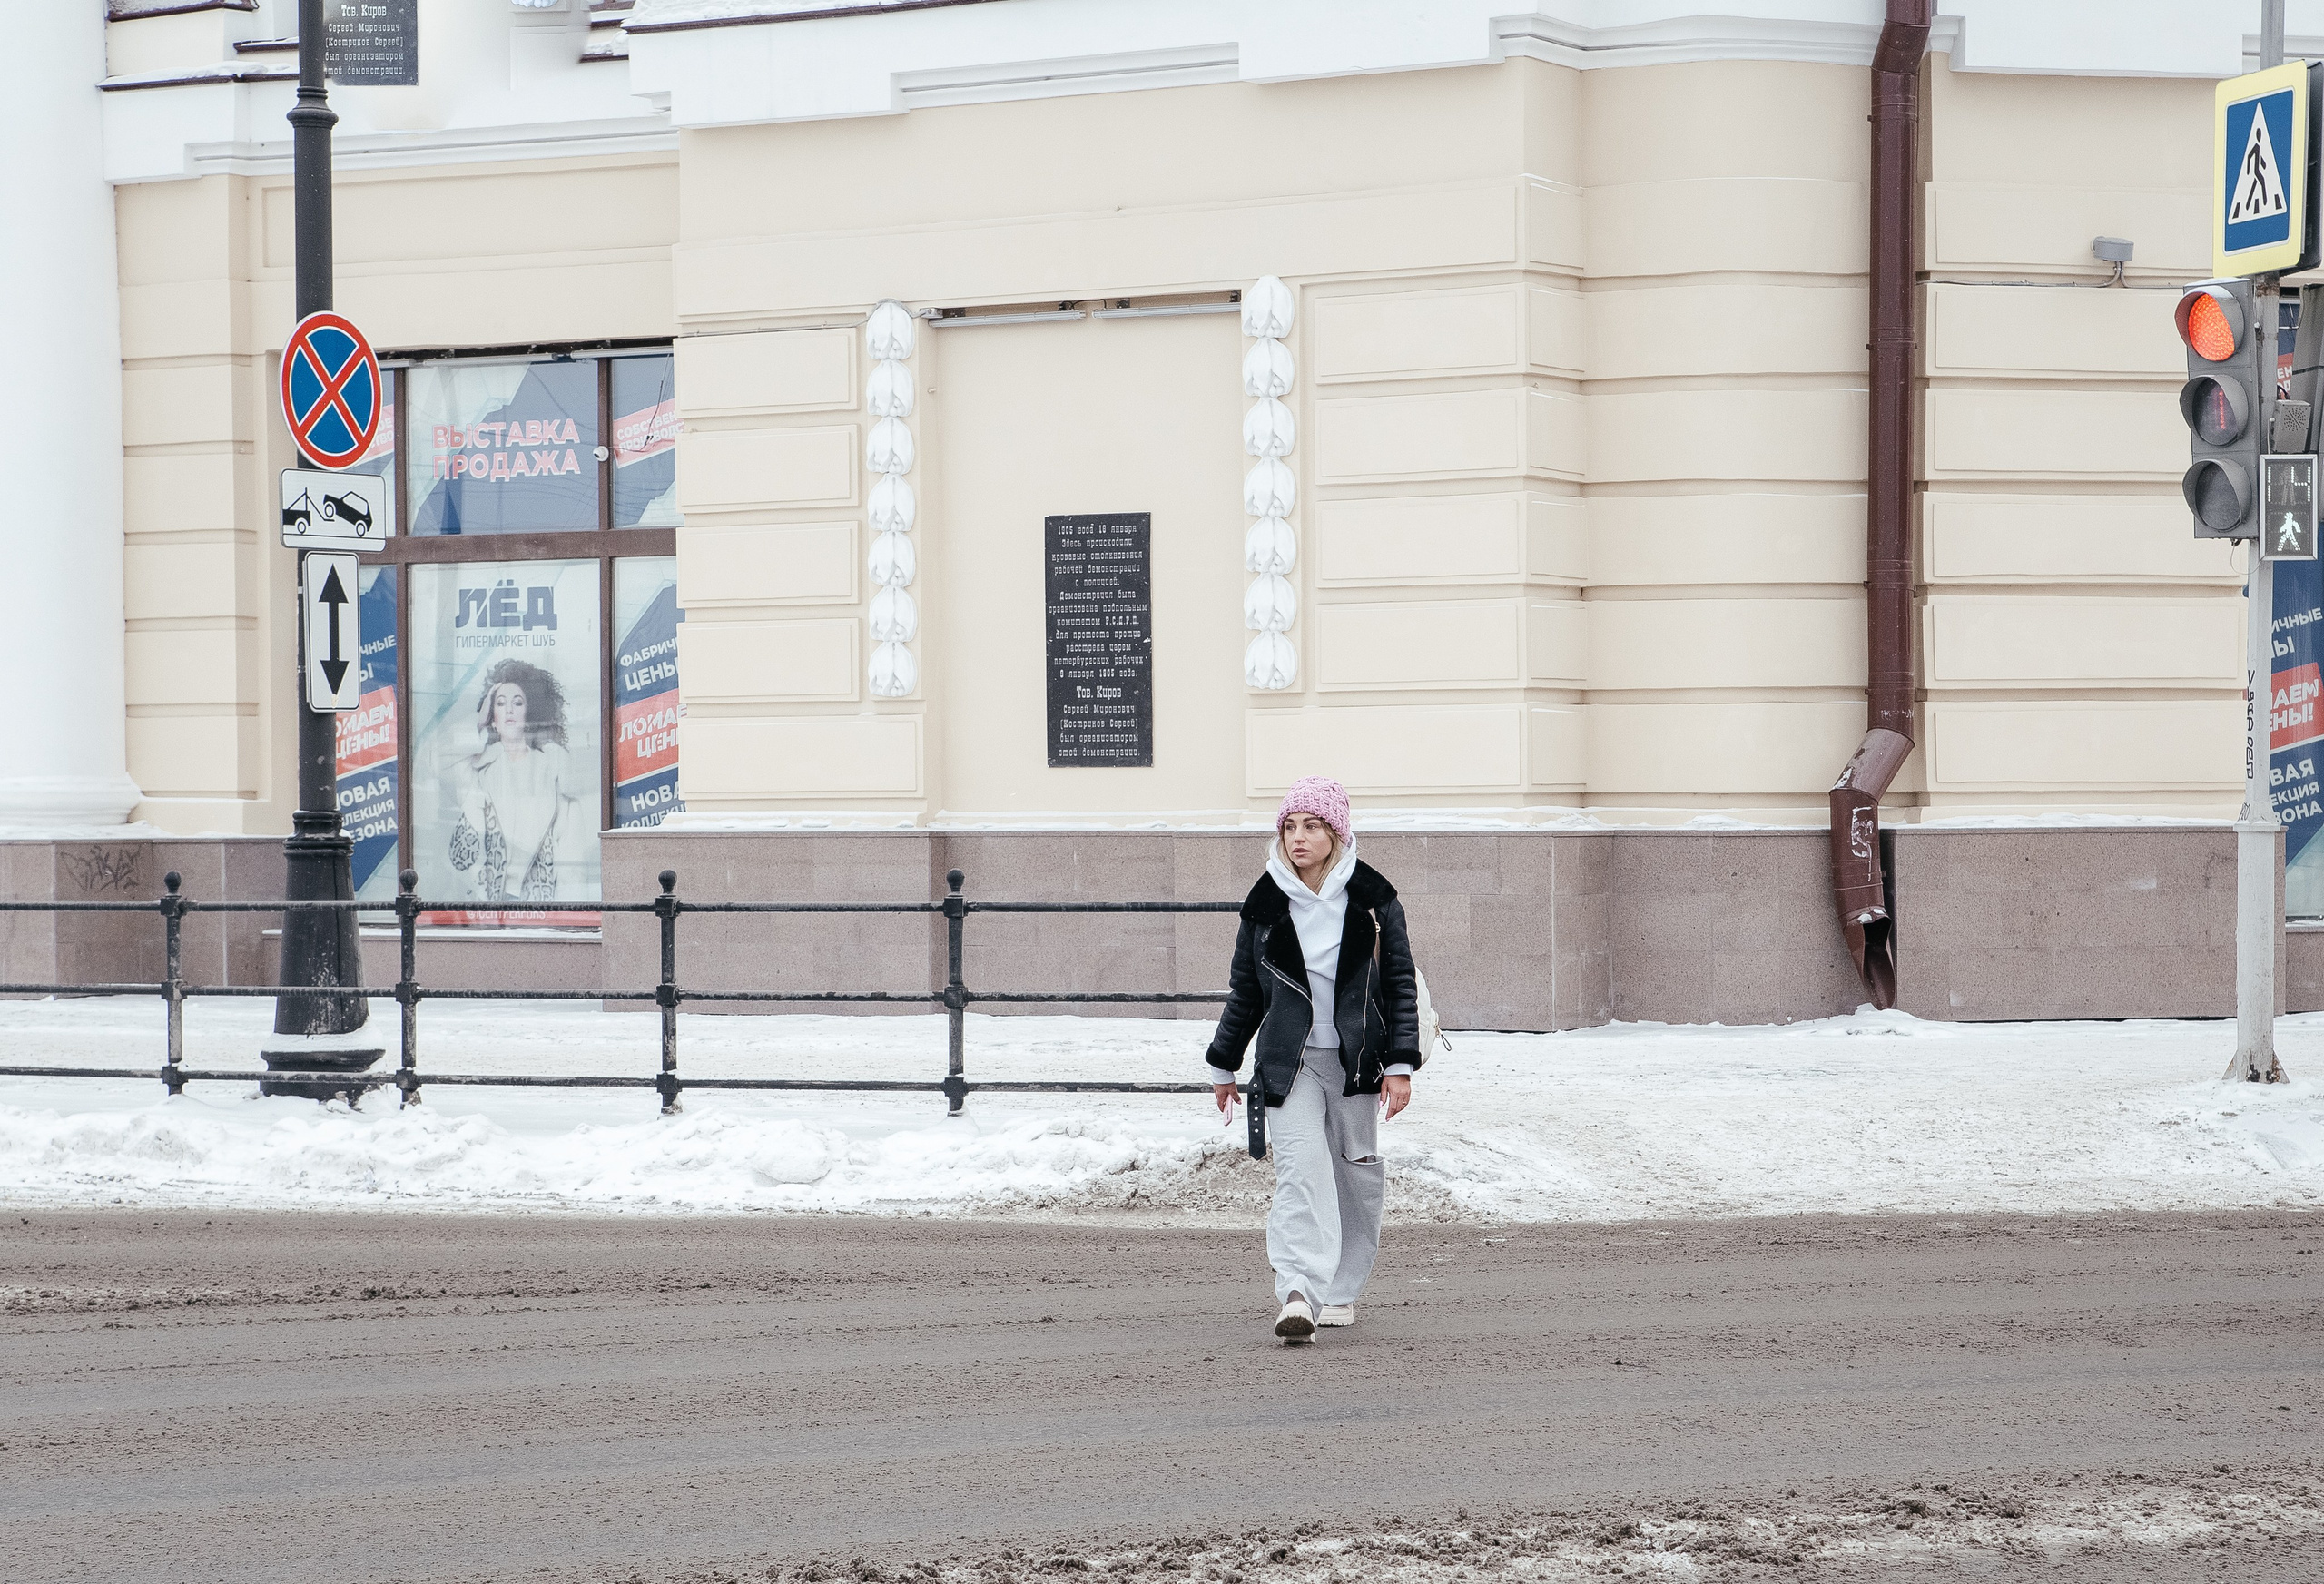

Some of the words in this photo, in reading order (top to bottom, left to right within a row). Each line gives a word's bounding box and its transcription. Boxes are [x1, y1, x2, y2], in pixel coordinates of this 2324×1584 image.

[340, 4, 359, 17] Тов.
[361, 4, 387, 18] Киров
[328, 23, 353, 33] Сергей
[358, 23, 400, 33] Миронович
[325, 52, 340, 61] был
[344, 52, 404, 62] организатором
[432, 418, 580, 448] ВЫСТАВКА
[433, 448, 581, 482] ПРОДАЖА
[2267, 466, 2311, 502] 14
[1058, 525, 1073, 535] 1905
[1078, 525, 1094, 535] года
[1110, 525, 1137, 534] января
[1061, 538, 1082, 547] Здесь
[1086, 536, 1133, 548] происходили
[1051, 551, 1086, 562] кровавые
[1090, 550, 1143, 560] столкновения
[1054, 565, 1083, 576] рабочей
[1088, 564, 1140, 574] демонстрации
[1059, 590, 1113, 601] Демонстрация
[1118, 589, 1136, 599] была
[455, 579, 557, 631] ЛЁД
[1049, 605, 1098, 615] организована
[1102, 603, 1147, 613] подпольным
[1056, 616, 1100, 626] комитетом
[1055, 629, 1068, 639] для
[1073, 630, 1110, 640] протеста
[1114, 629, 1141, 639] против
[456, 635, 529, 648] ГИПЕРМАРКЕТ
[532, 634, 556, 647] ШУБ
[620, 636, 678, 667] ФАБРИЧ
[1066, 644, 1105, 653] расстрела
[1109, 643, 1132, 653] царем
[1054, 655, 1109, 666] петербургских
[1114, 654, 1144, 665] рабочих
[1059, 669, 1064, 678] 9
[1068, 670, 1094, 679] января
[1099, 668, 1115, 677] 1905
[1119, 668, 1138, 677] года.
[1076, 685, 1094, 698] Тов.
[1096, 685, 1122, 700] Киров
[1063, 704, 1088, 714] Сергей
[1093, 704, 1135, 714] Миронович
[1059, 733, 1074, 742] был
[1078, 733, 1139, 743] организатором
[1059, 748, 1078, 757] этой
[1082, 747, 1140, 757] демонстрации.
[341, 798, 396, 827] ЛЕКЦИЯ
